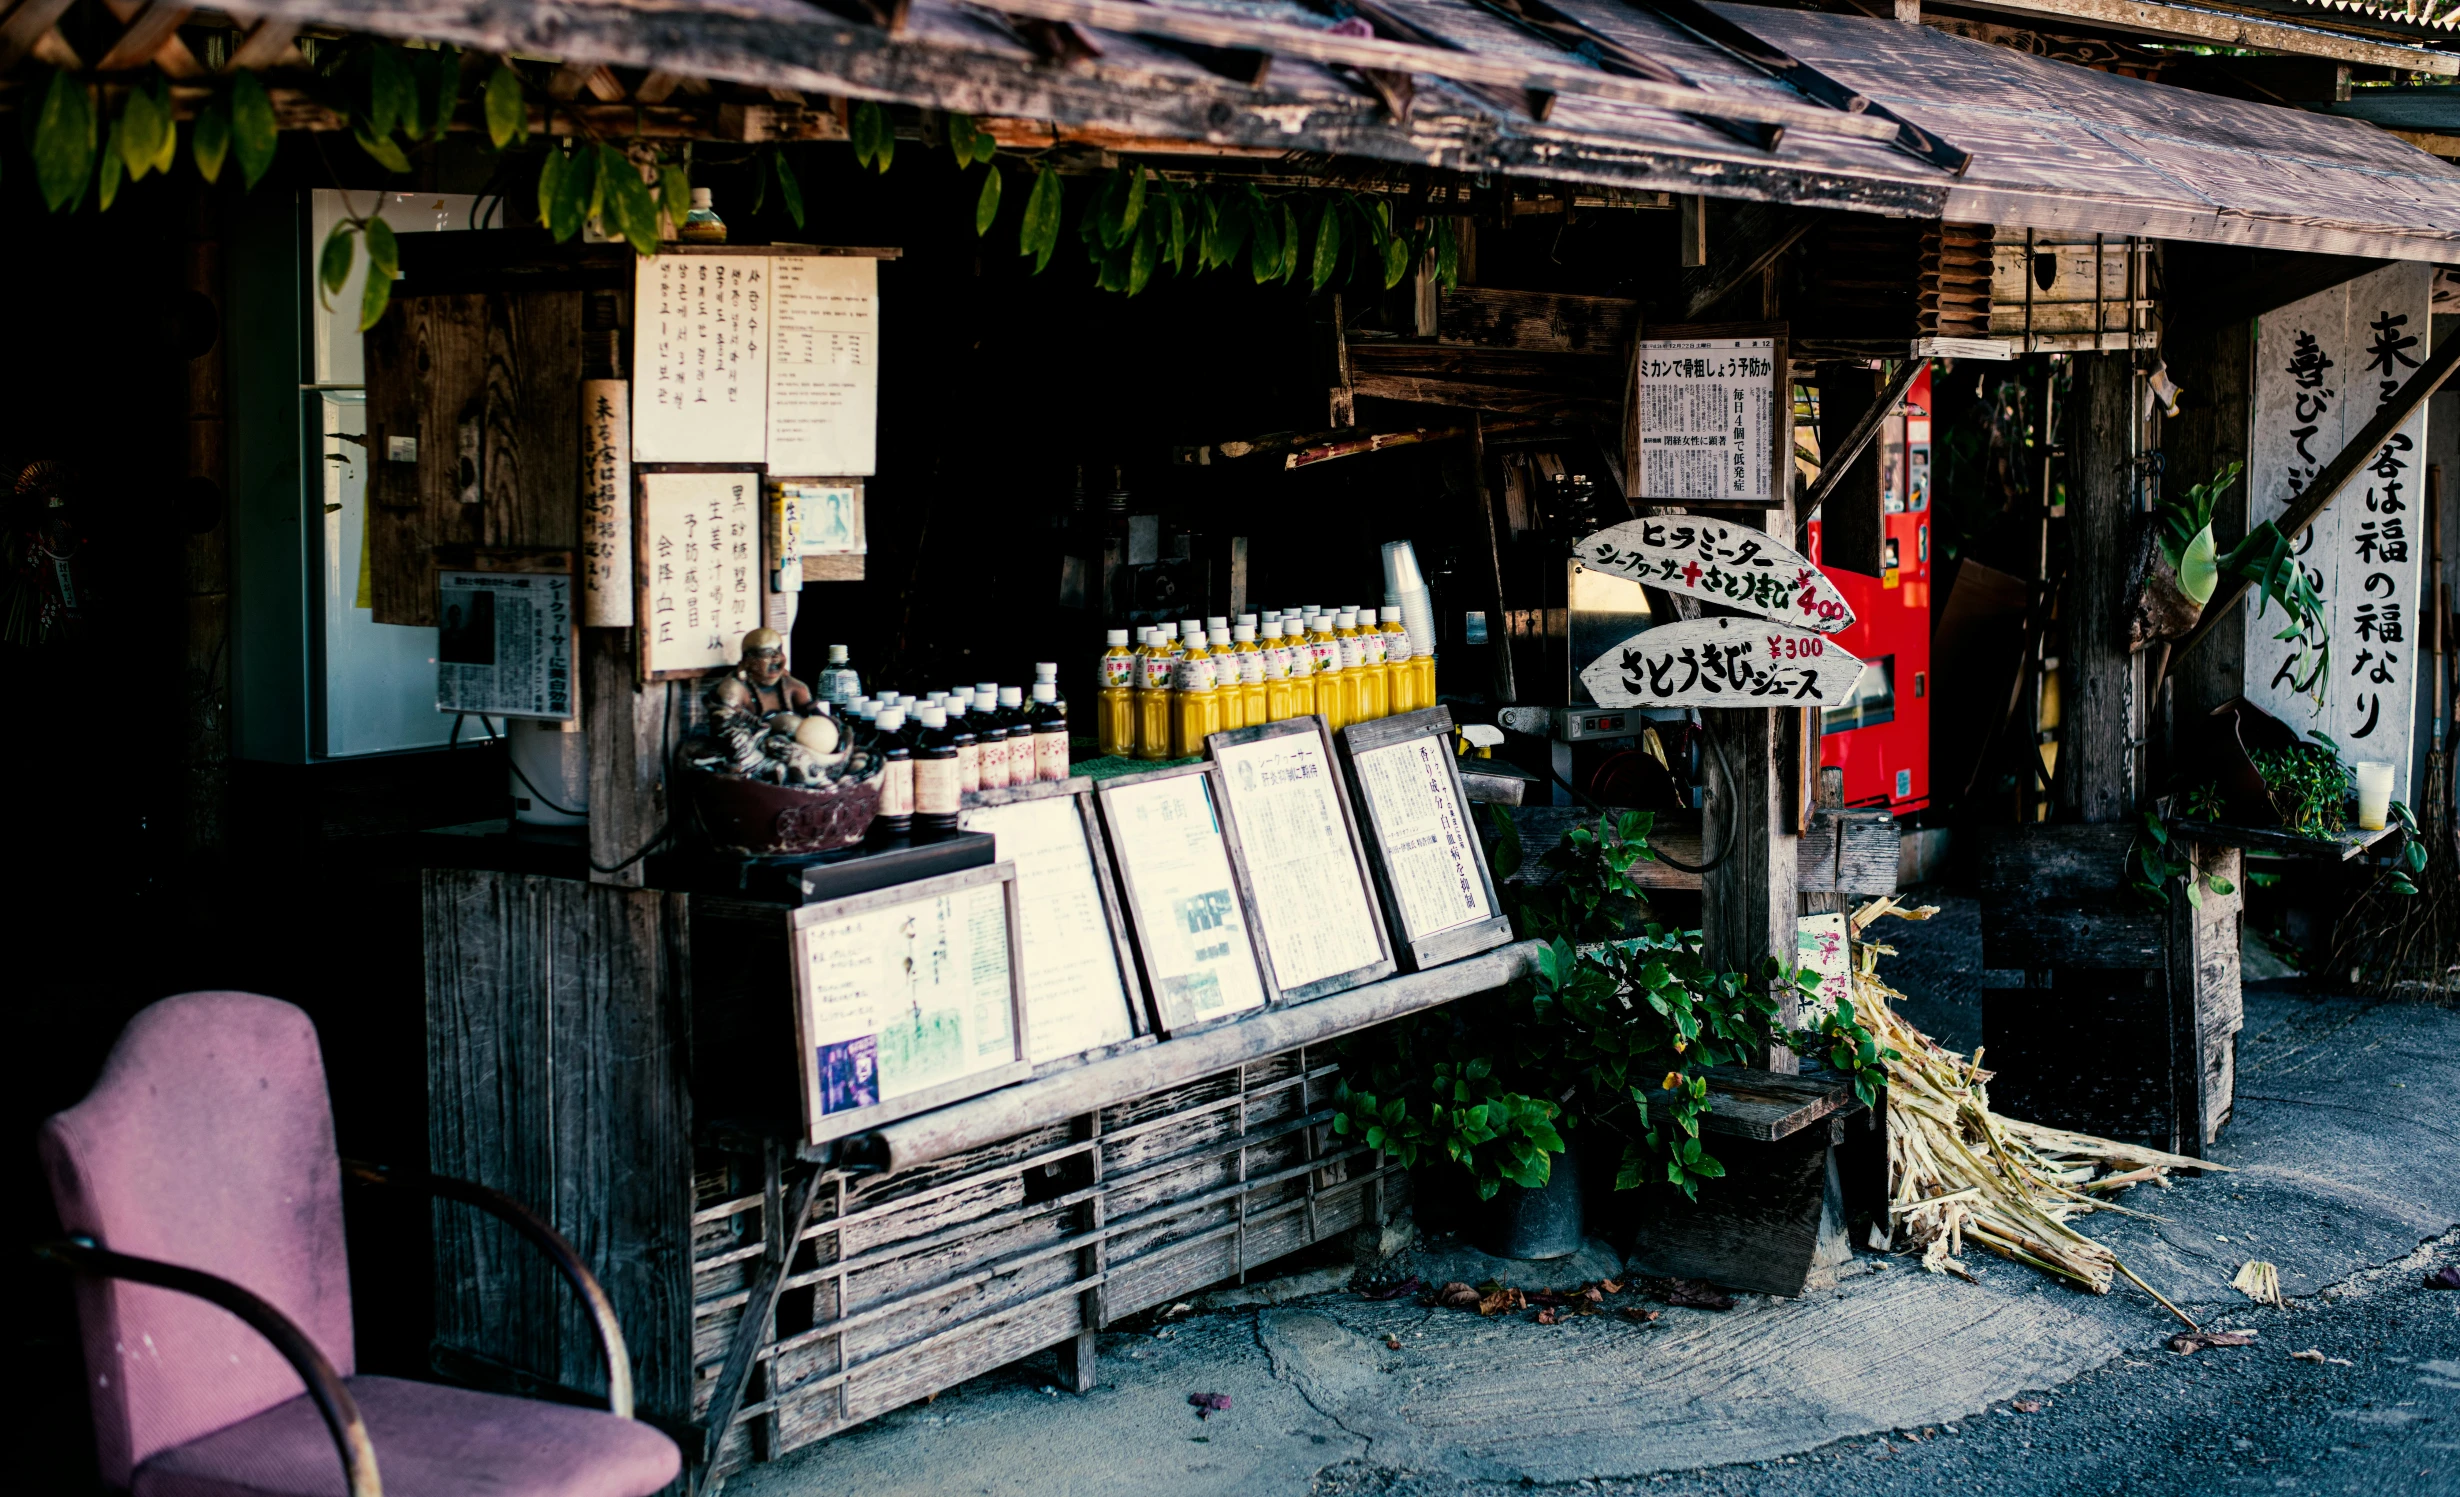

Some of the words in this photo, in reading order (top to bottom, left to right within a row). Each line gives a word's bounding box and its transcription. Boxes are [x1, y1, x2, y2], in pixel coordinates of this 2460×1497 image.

[660, 263, 670, 314] 냉장고
[678, 264, 688, 341] 상온에서
[747, 269, 761, 359] 사탕수수
[657, 366, 669, 404] 보관
[1641, 358, 1771, 378] ミカンで骨粗しょう予防か
[1664, 436, 1727, 446] 閉経女性に顕著
[1733, 388, 1745, 492] 毎日4個で低発症
[595, 396, 617, 579] 来る客は福の福なり
[1642, 519, 1774, 567] ヒラミーター
[2350, 310, 2421, 739] 来る客は福の福なり
[707, 499, 724, 650] 生姜汁喝可以
[1797, 568, 1845, 620] ¥400
[1619, 641, 1823, 699] さとうきびジュース
[1766, 634, 1824, 659] ¥300
[1261, 763, 1319, 787] 肝炎抑制に期待
[1419, 746, 1443, 810] 香り成分
[1440, 814, 1476, 909] 白血病を抑制
